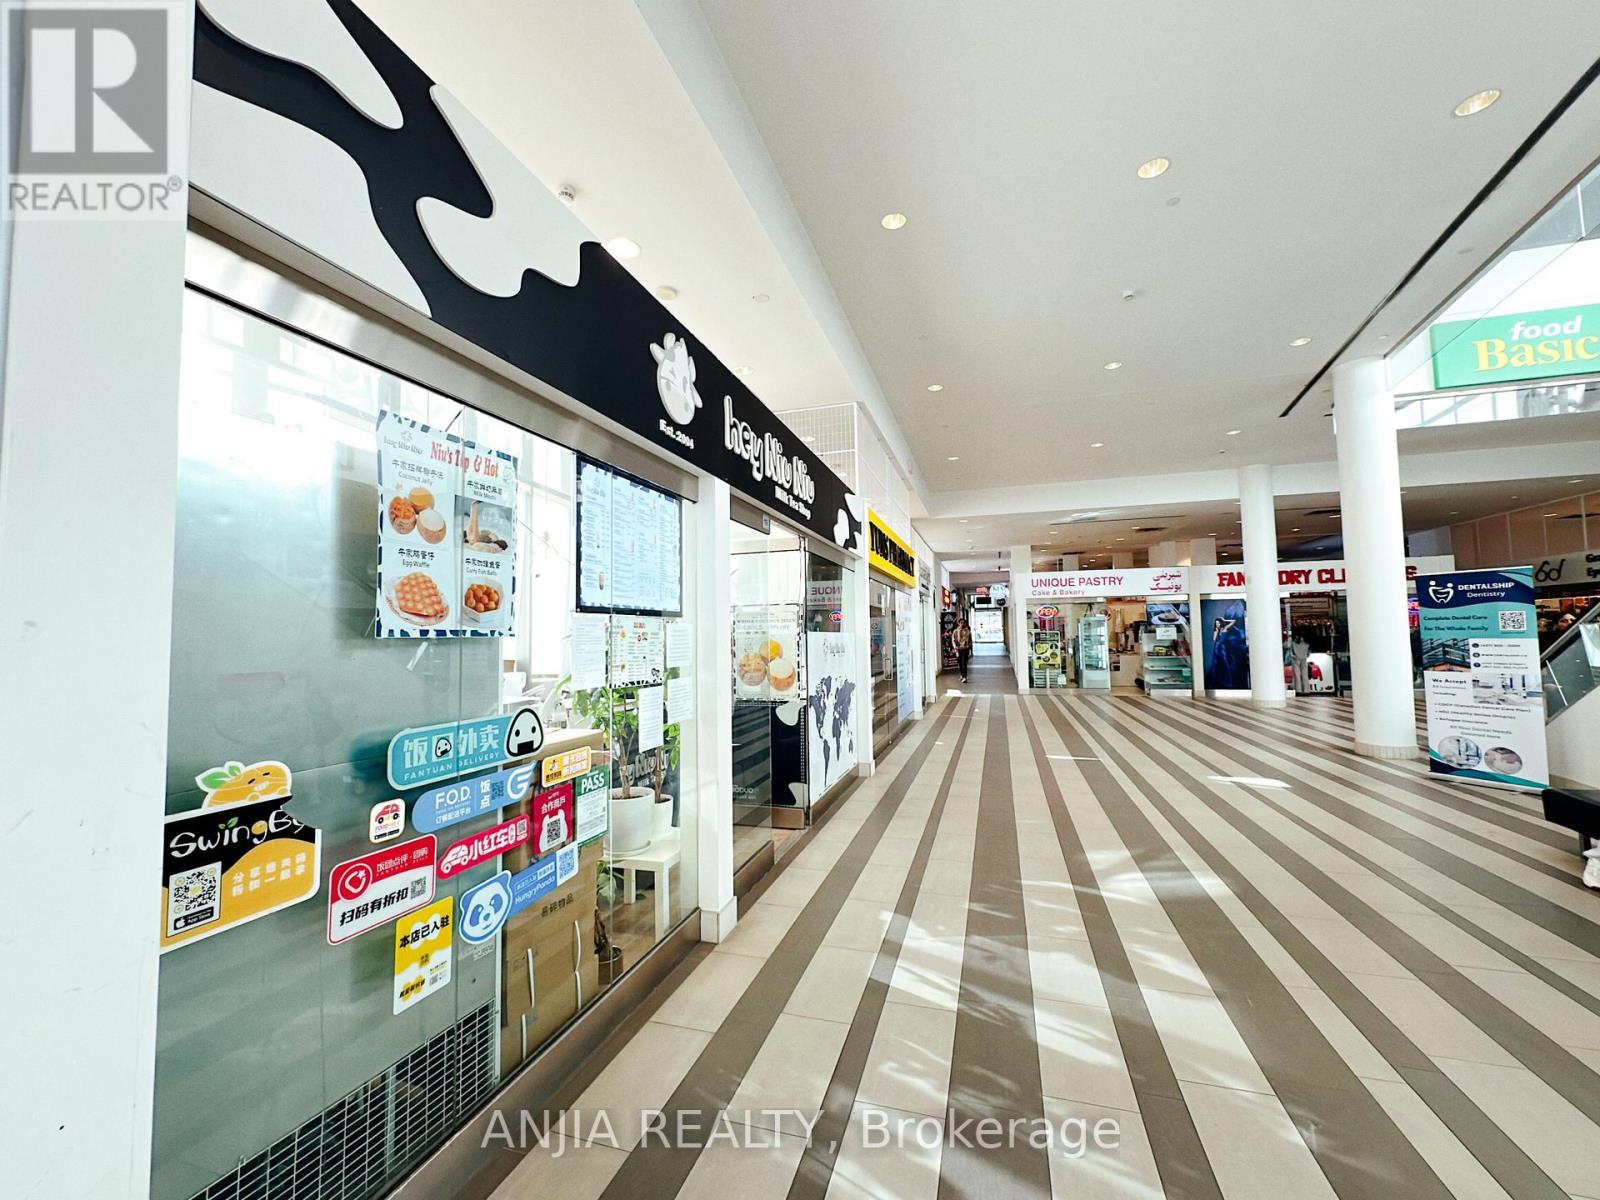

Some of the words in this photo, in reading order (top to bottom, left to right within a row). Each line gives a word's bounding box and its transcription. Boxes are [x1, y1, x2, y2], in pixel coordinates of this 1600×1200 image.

[1510, 314, 1583, 341] food
[723, 395, 764, 481] hey
[764, 432, 793, 490] Niu
[792, 456, 815, 504] Niu
[484, 457, 499, 478] Hot
[1031, 577, 1075, 588] UNIQUE
[1078, 576, 1124, 587] PASTRY
[1217, 572, 1246, 587] FAN
[1278, 568, 1313, 586] DRY
[1457, 582, 1515, 591] DENTALSHIP
[403, 765, 453, 781] FANTUAN
[458, 751, 500, 768] DELIVERY
[479, 779, 491, 810] 饭点
[581, 772, 605, 794] PASS
[434, 786, 472, 810] F.O.D.
[169, 808, 306, 858] SwingBy
[468, 826, 509, 860] 小红车
[514, 875, 556, 904] HungryPanda
[339, 887, 409, 926] 扫码有折扣
[399, 914, 450, 949] 本店已入驻
